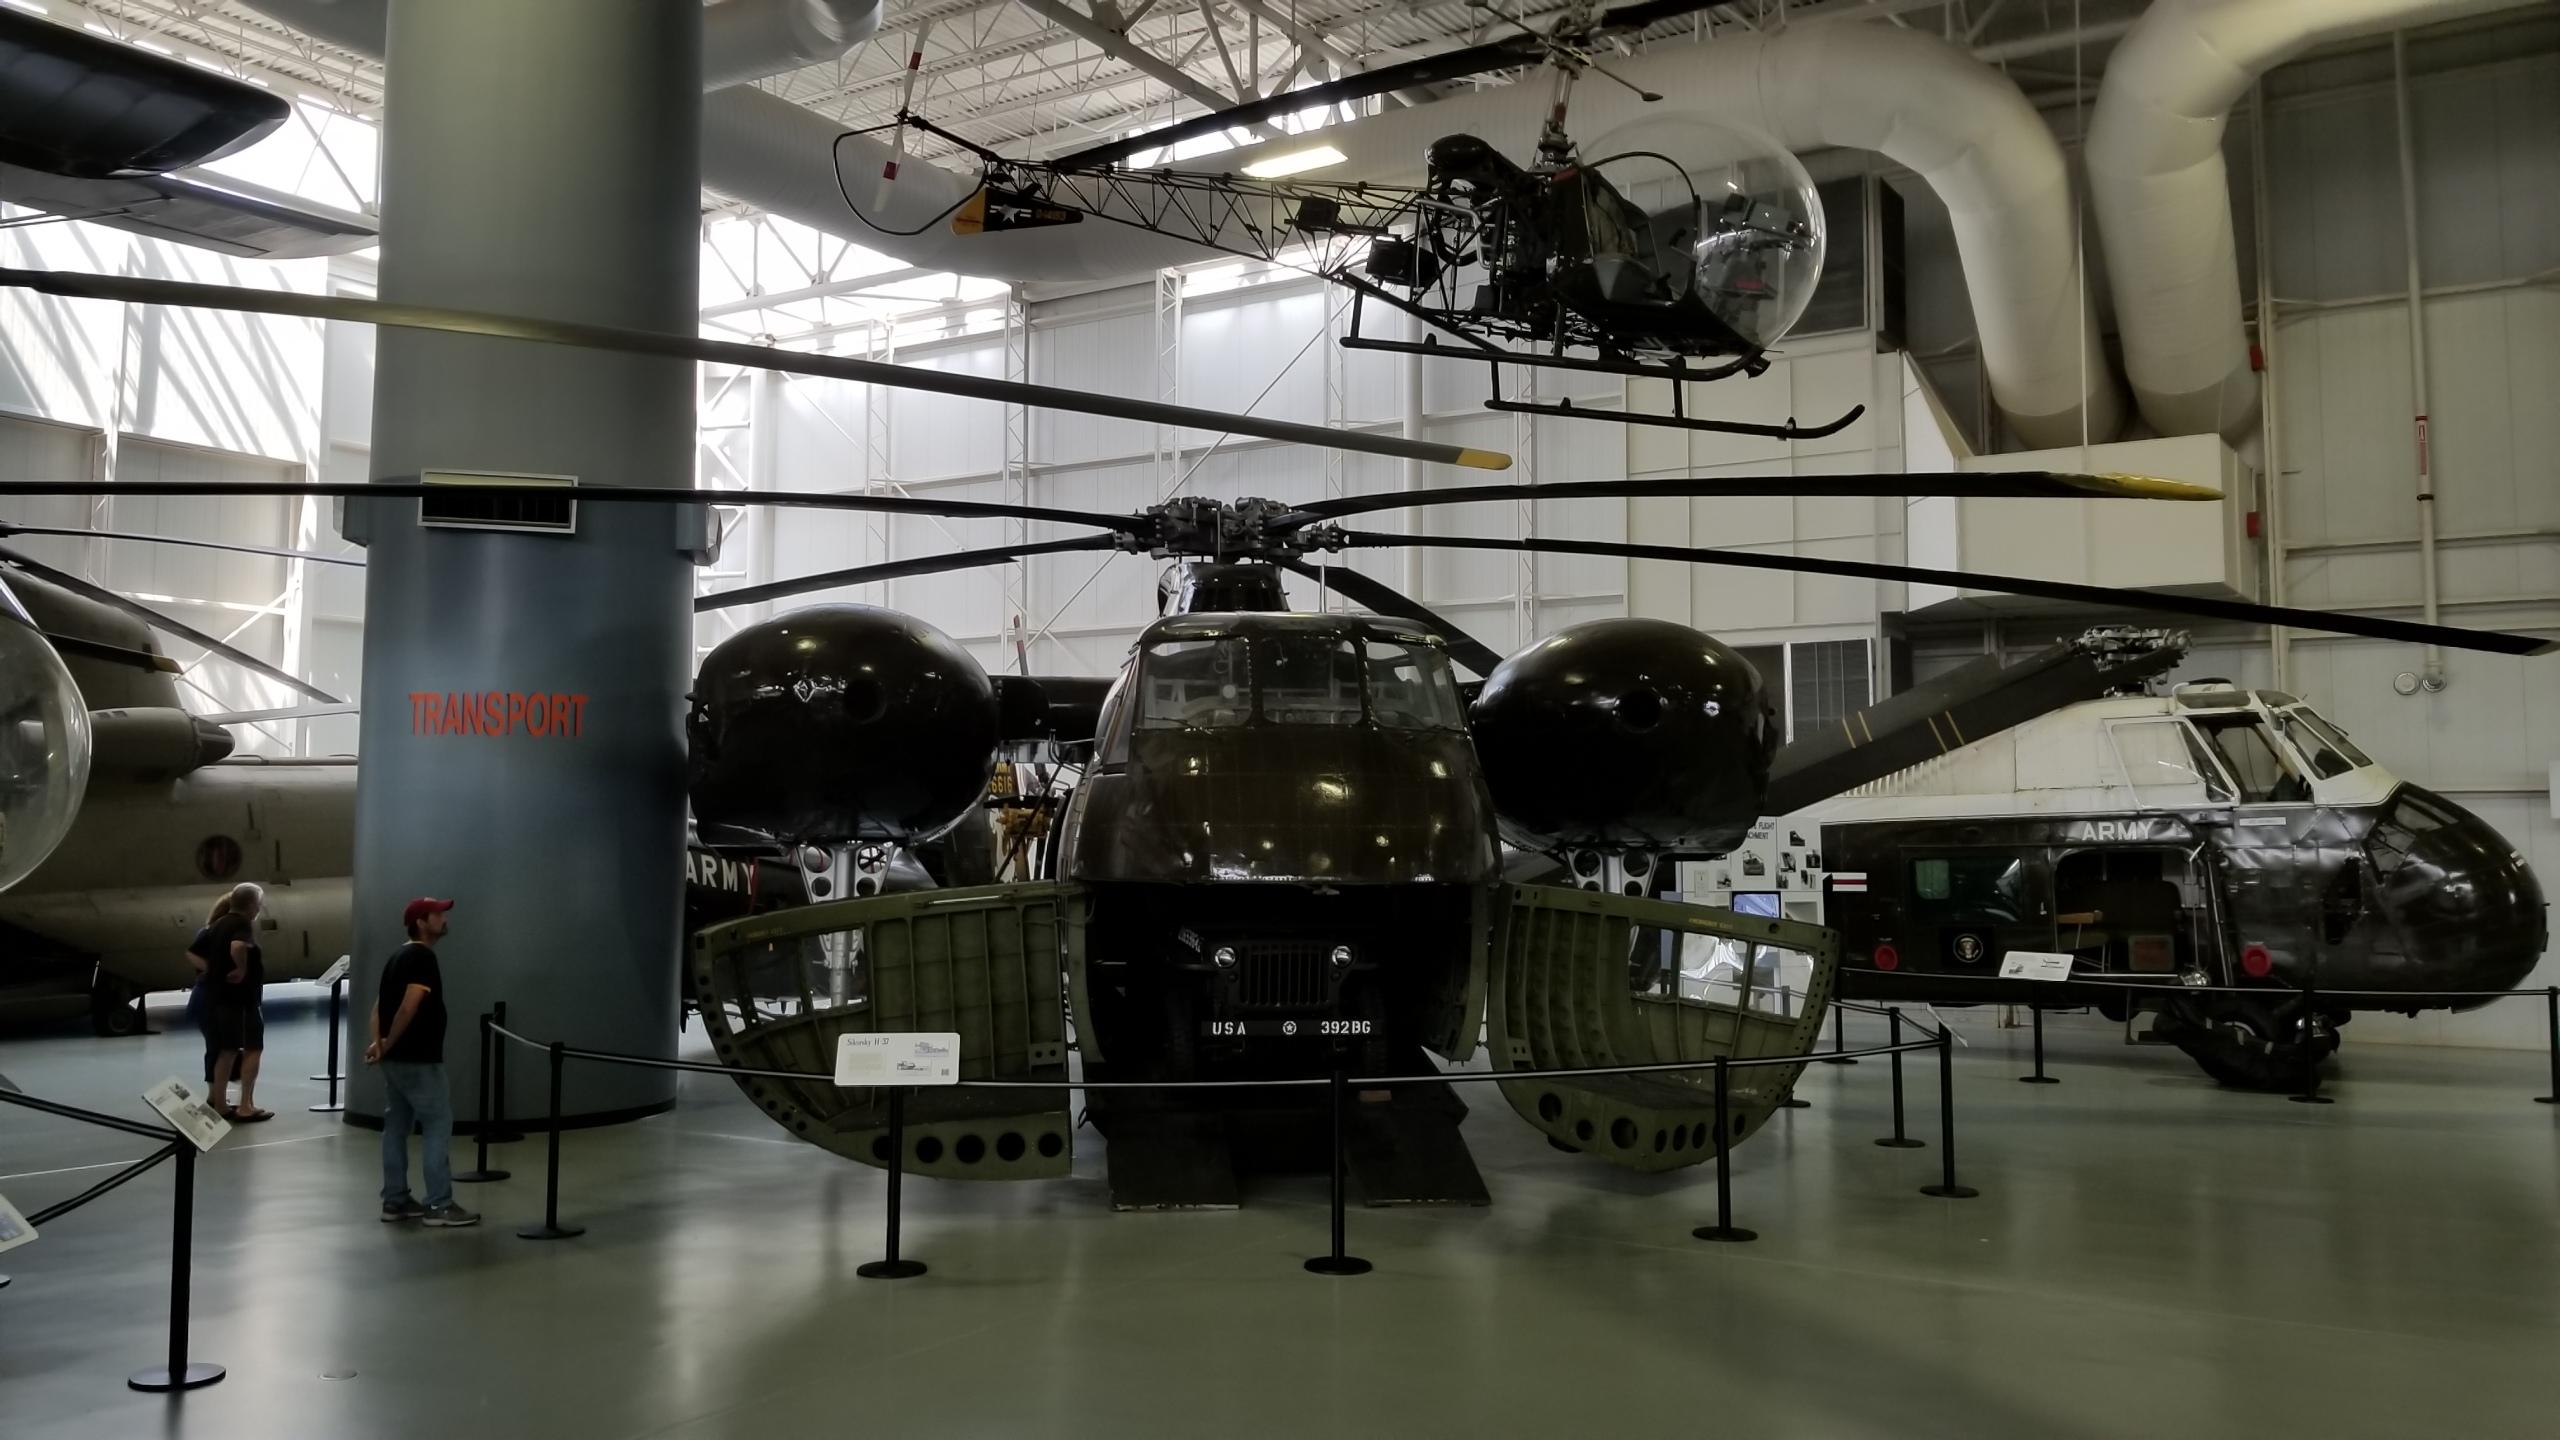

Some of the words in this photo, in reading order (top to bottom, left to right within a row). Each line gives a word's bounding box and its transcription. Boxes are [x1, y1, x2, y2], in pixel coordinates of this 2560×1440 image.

[408, 690, 589, 738] TRANSPORT
[2081, 821, 2154, 841] ARMY
[686, 851, 755, 896] ARMY
[1212, 1021, 1247, 1036] USA
